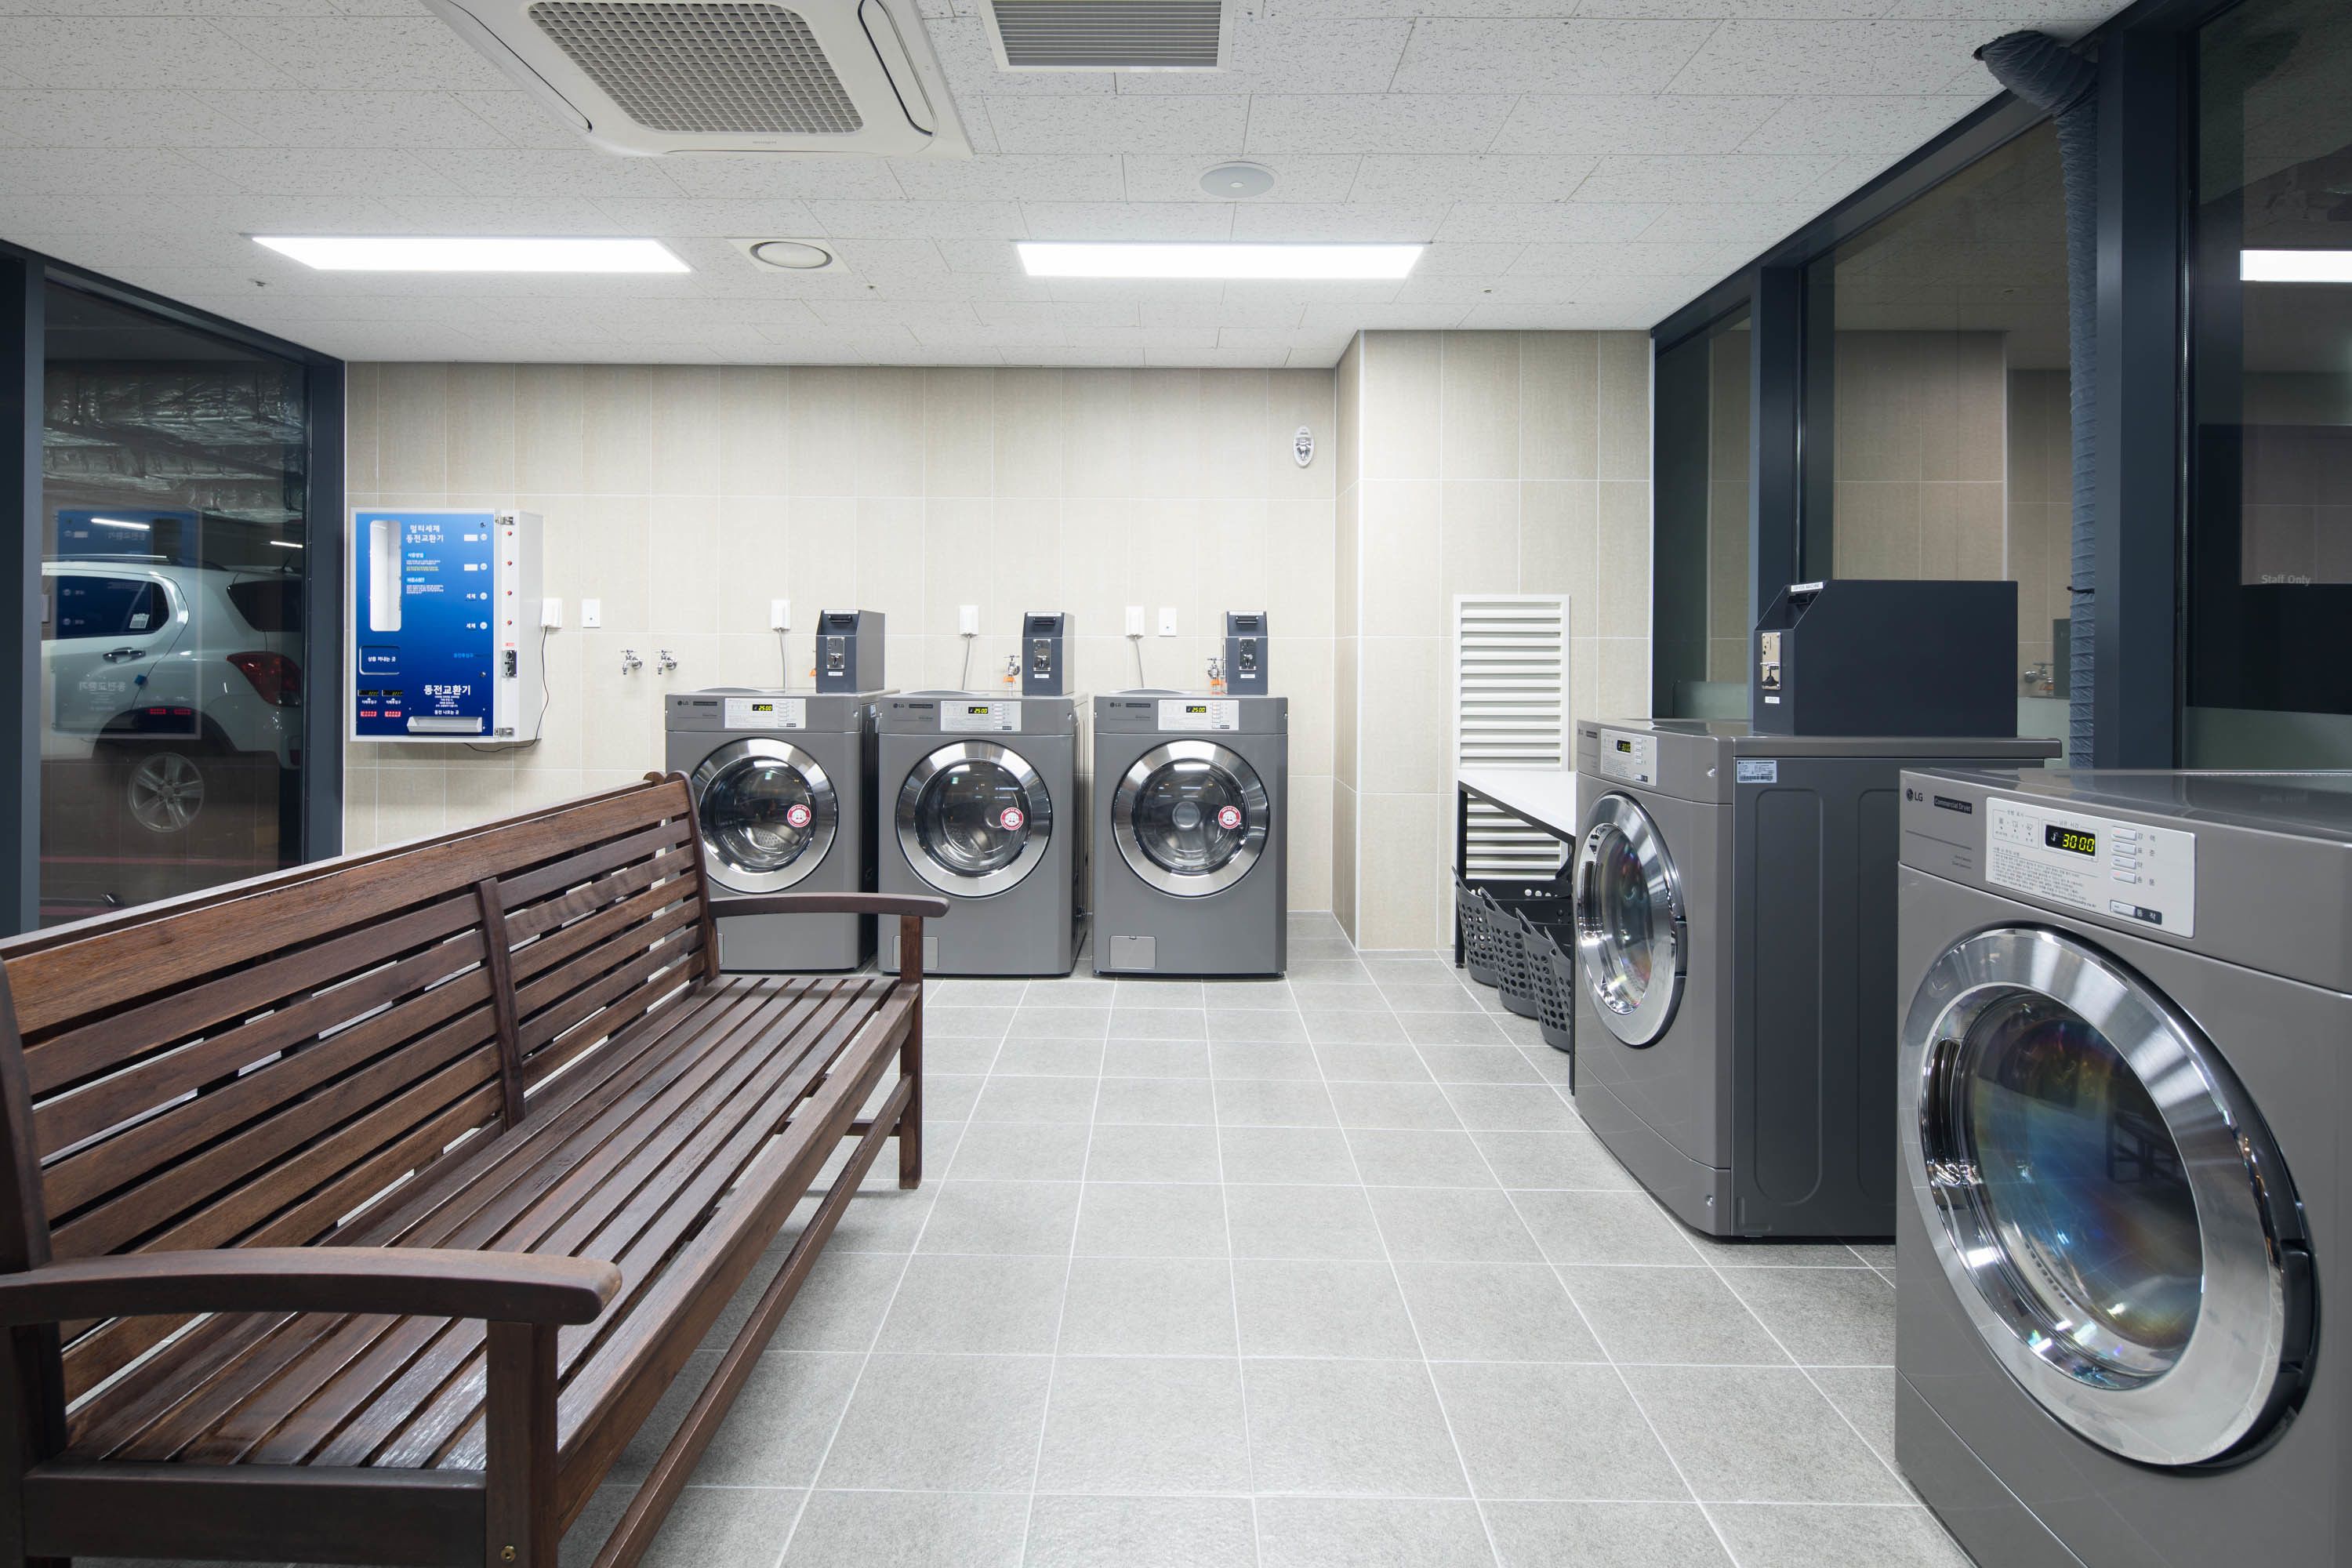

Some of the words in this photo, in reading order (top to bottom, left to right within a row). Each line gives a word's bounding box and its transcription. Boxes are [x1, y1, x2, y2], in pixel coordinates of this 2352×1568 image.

[406, 534, 444, 543] 동전교환기
[2261, 575, 2285, 584] Staff
[2288, 575, 2311, 586] Only
[423, 684, 470, 696] 동전교환기
[1914, 791, 1923, 802] LG
[1935, 797, 1958, 809] Commercial
[1958, 803, 1971, 812] Dryer
[2063, 833, 2095, 852] 3000
